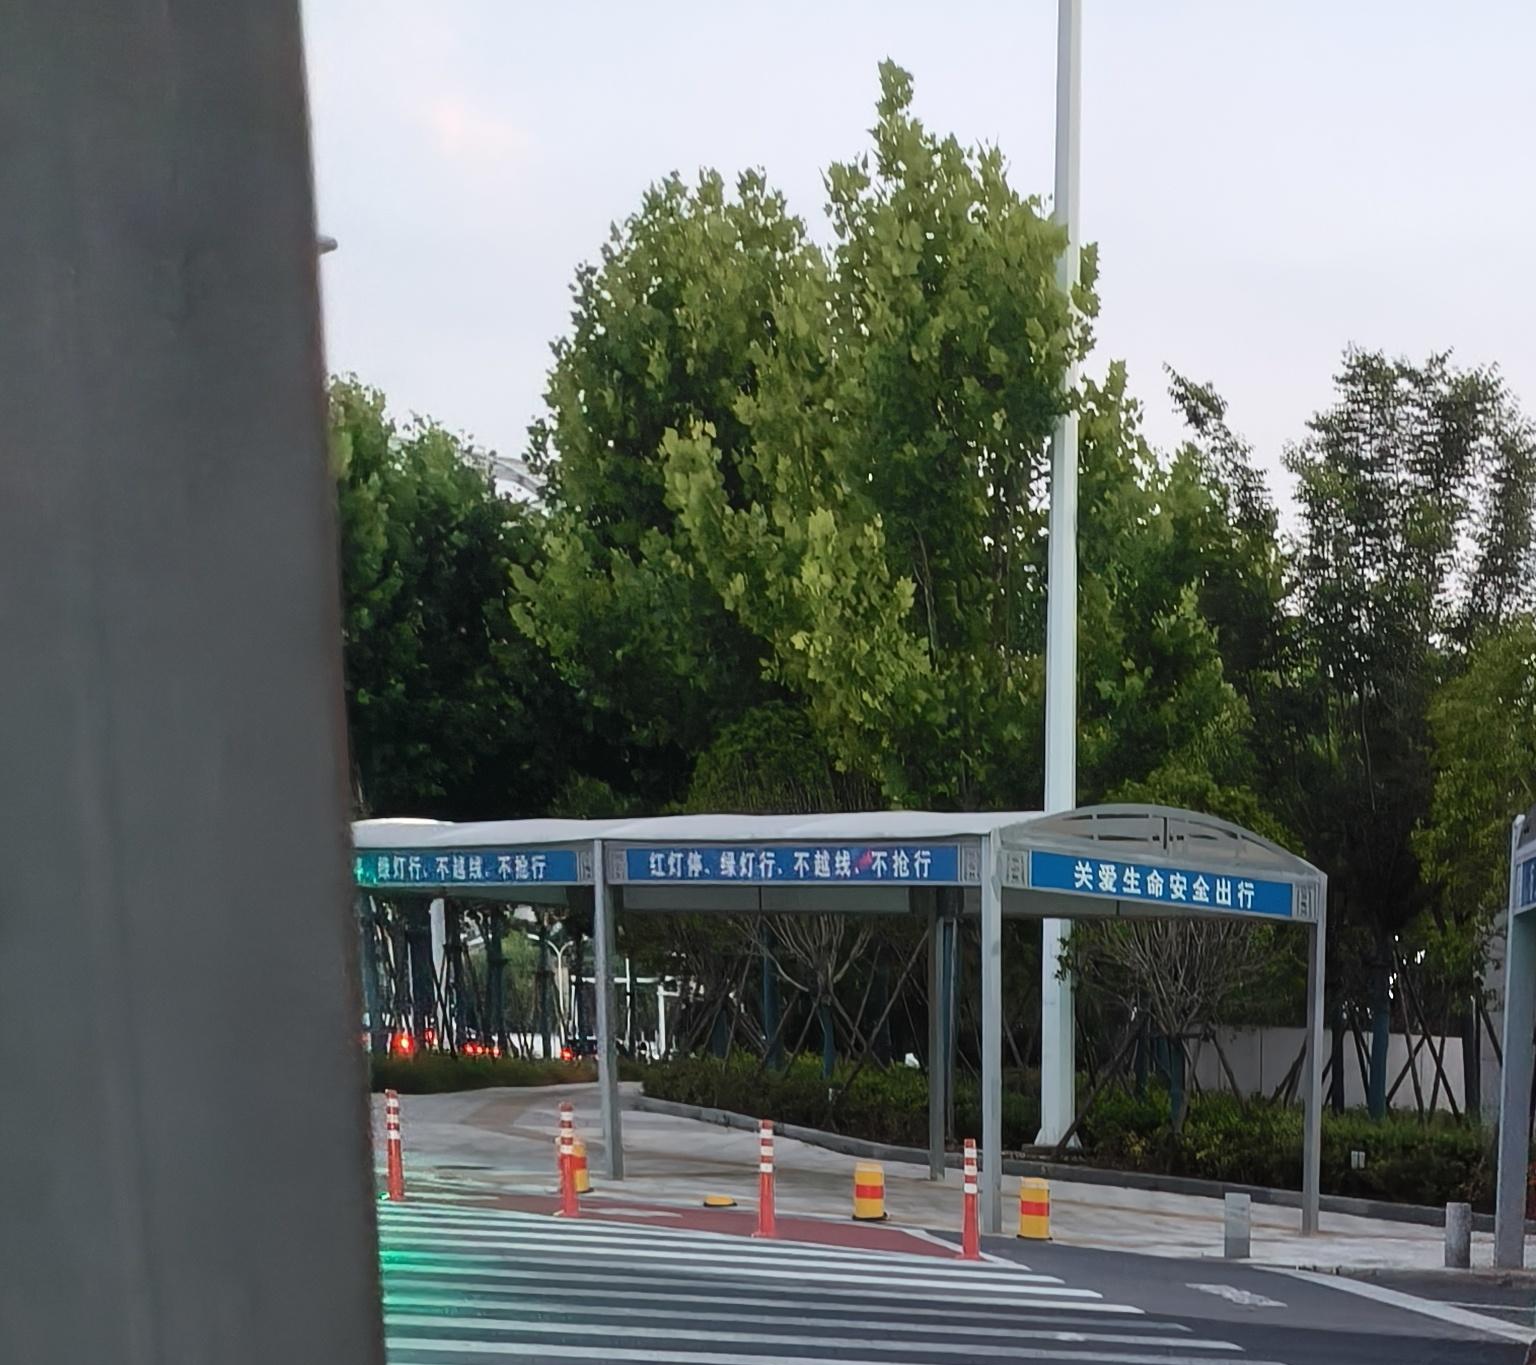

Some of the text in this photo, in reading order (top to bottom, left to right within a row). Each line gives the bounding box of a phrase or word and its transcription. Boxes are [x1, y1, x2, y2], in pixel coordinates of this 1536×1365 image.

[1073, 860, 1256, 909] 关爱生命安全出行
